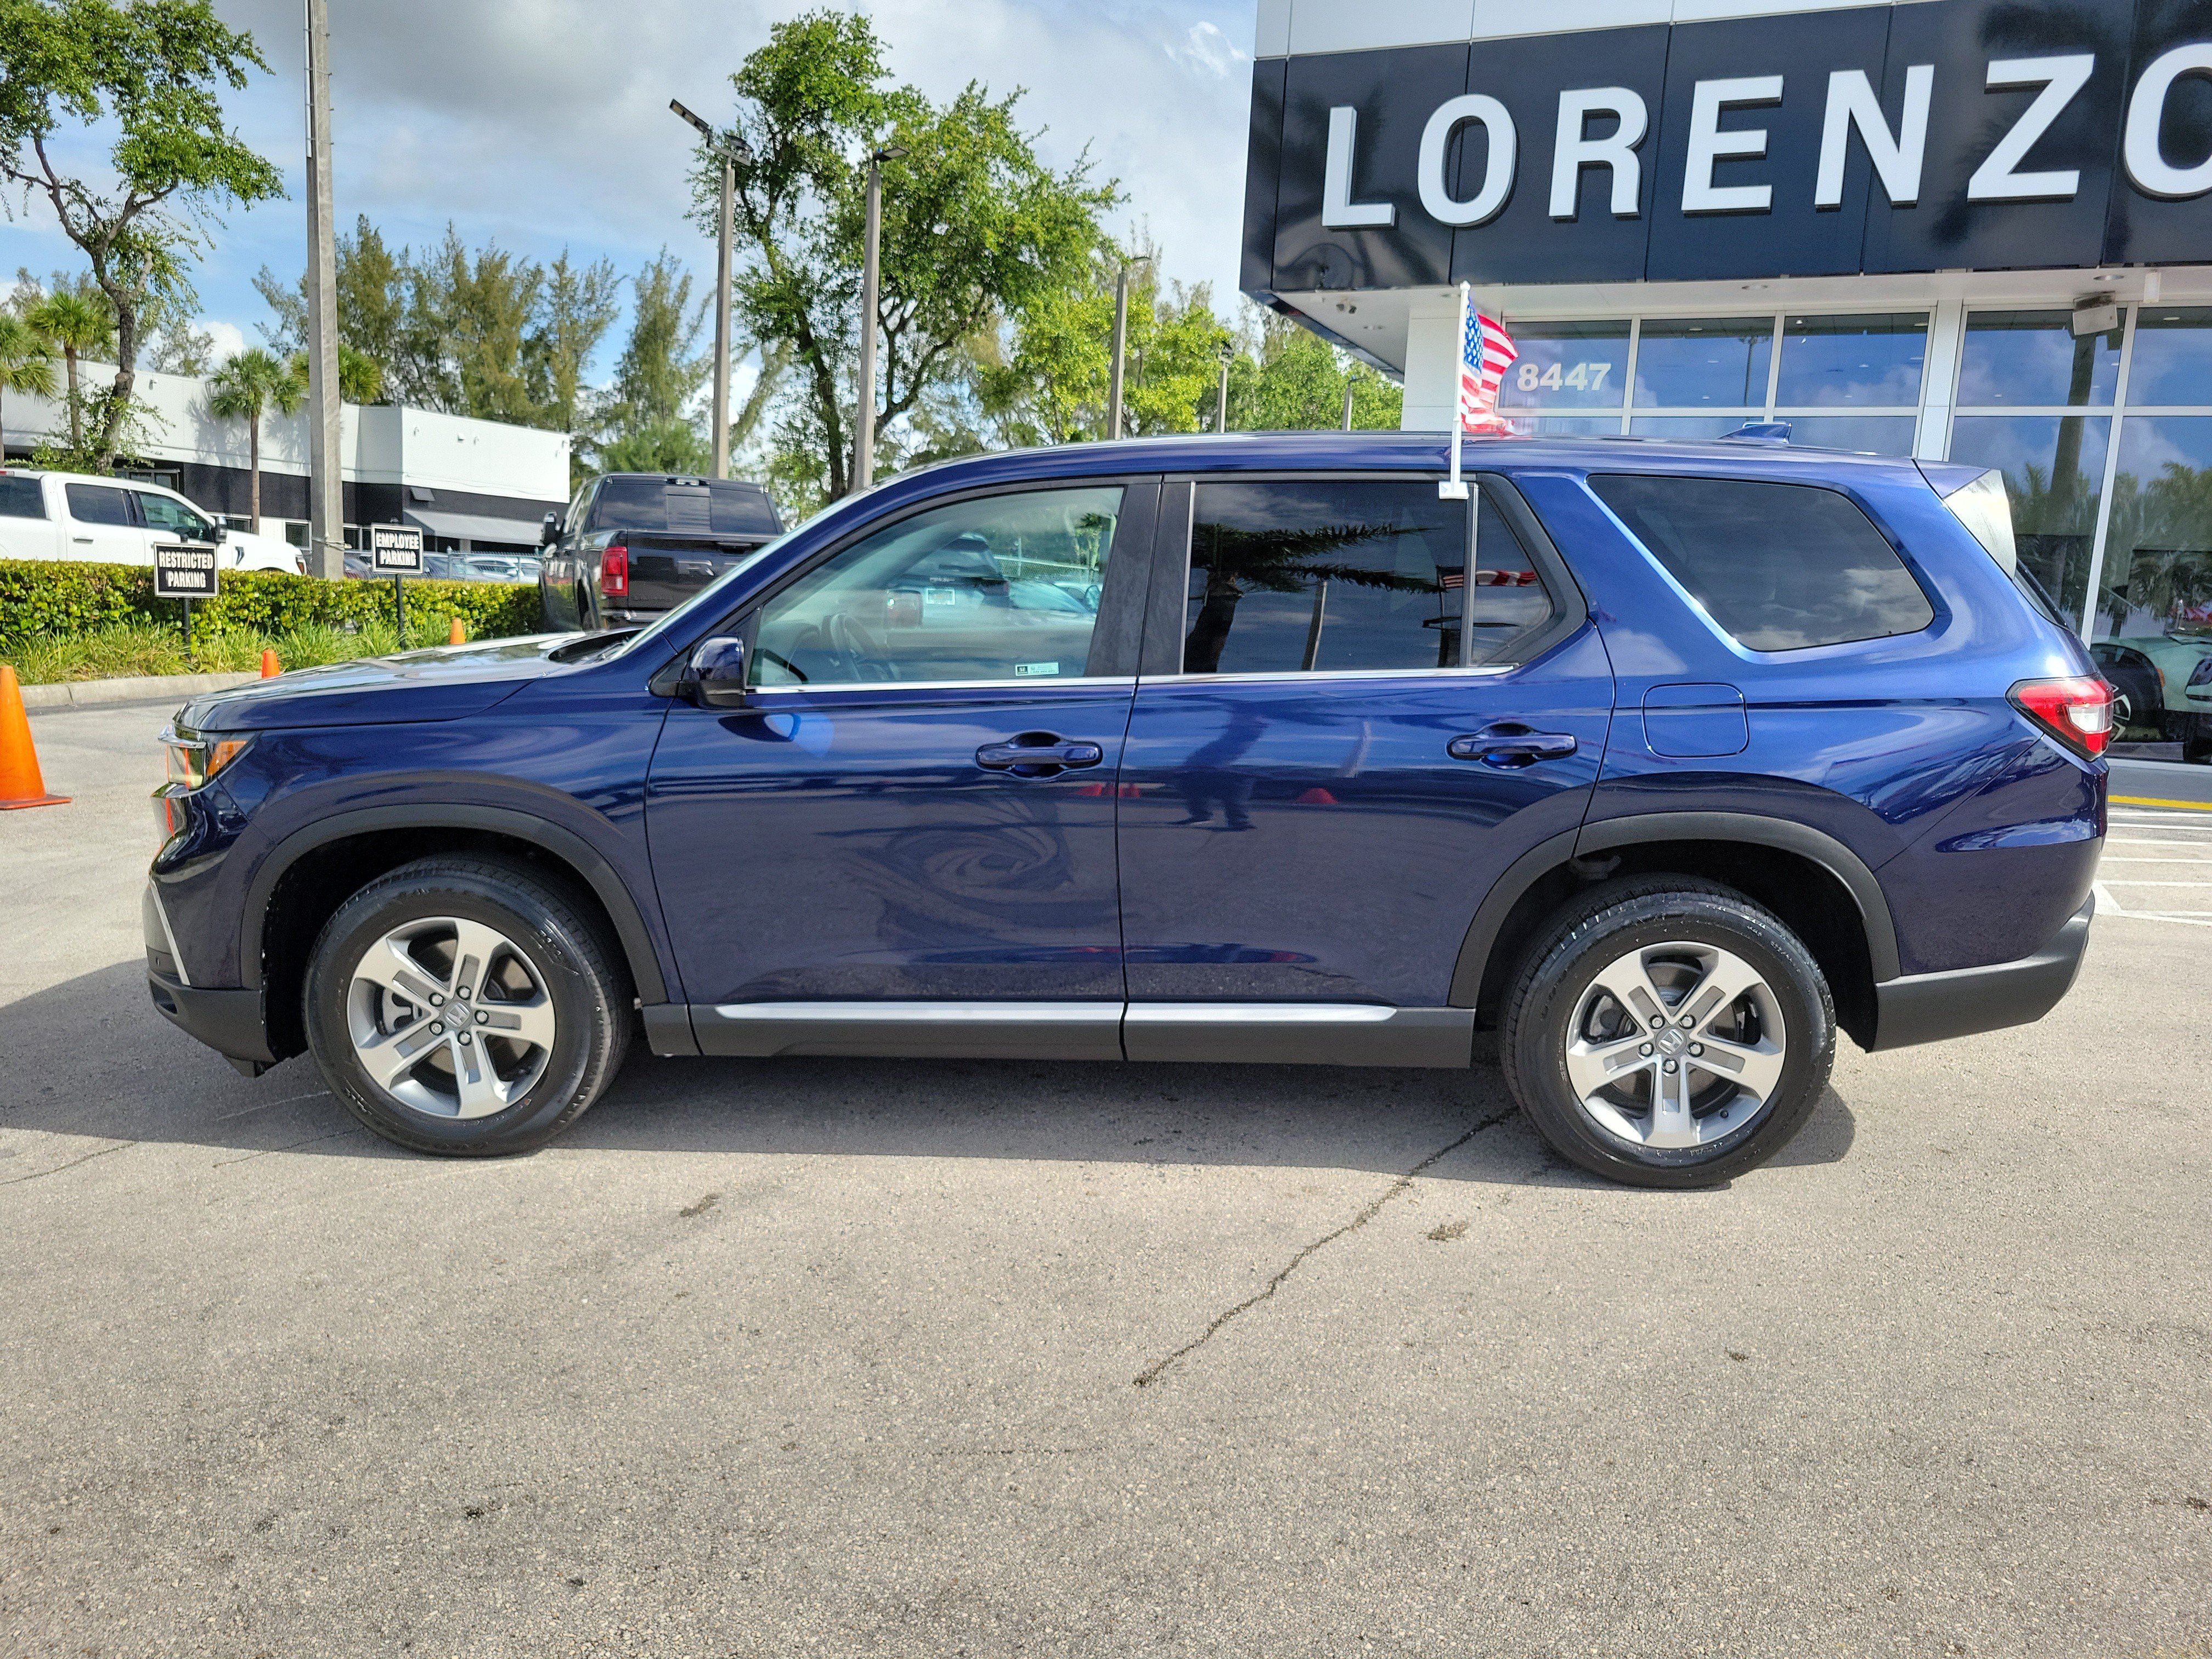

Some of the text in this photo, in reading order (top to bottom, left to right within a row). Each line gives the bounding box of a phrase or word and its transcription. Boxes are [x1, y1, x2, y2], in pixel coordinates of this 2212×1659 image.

[1322, 42, 2212, 227] LORENZO
[1517, 363, 1611, 391] 8447
[376, 532, 419, 549] EMPLOYEE
[159, 551, 213, 569] RESTRICTED
[380, 549, 416, 566] PARKING
[167, 571, 206, 588] PARKING
